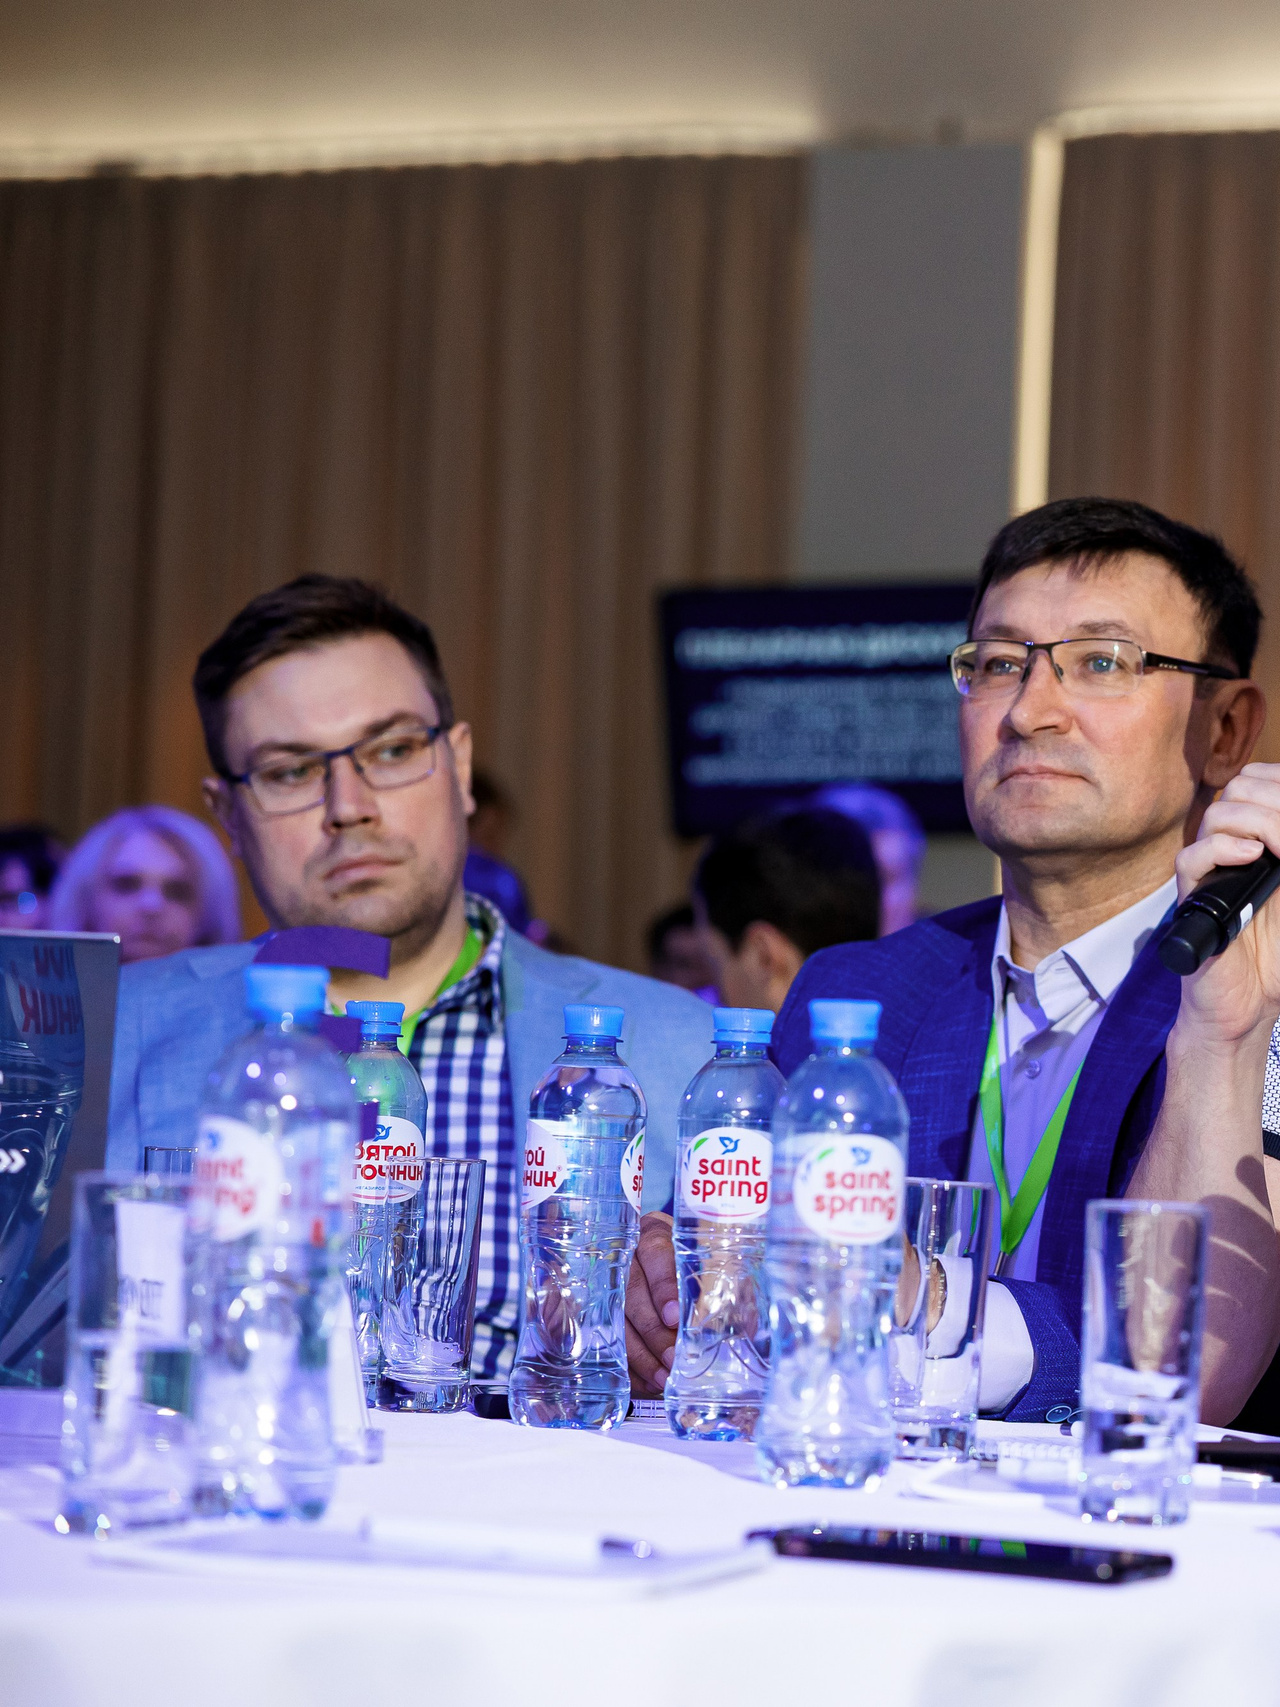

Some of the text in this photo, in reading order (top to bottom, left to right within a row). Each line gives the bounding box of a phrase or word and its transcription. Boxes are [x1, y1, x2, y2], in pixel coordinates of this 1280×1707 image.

[698, 1156, 762, 1177] saint
[691, 1179, 768, 1204] spring
[825, 1169, 892, 1191] saint
[814, 1193, 897, 1222] spring
